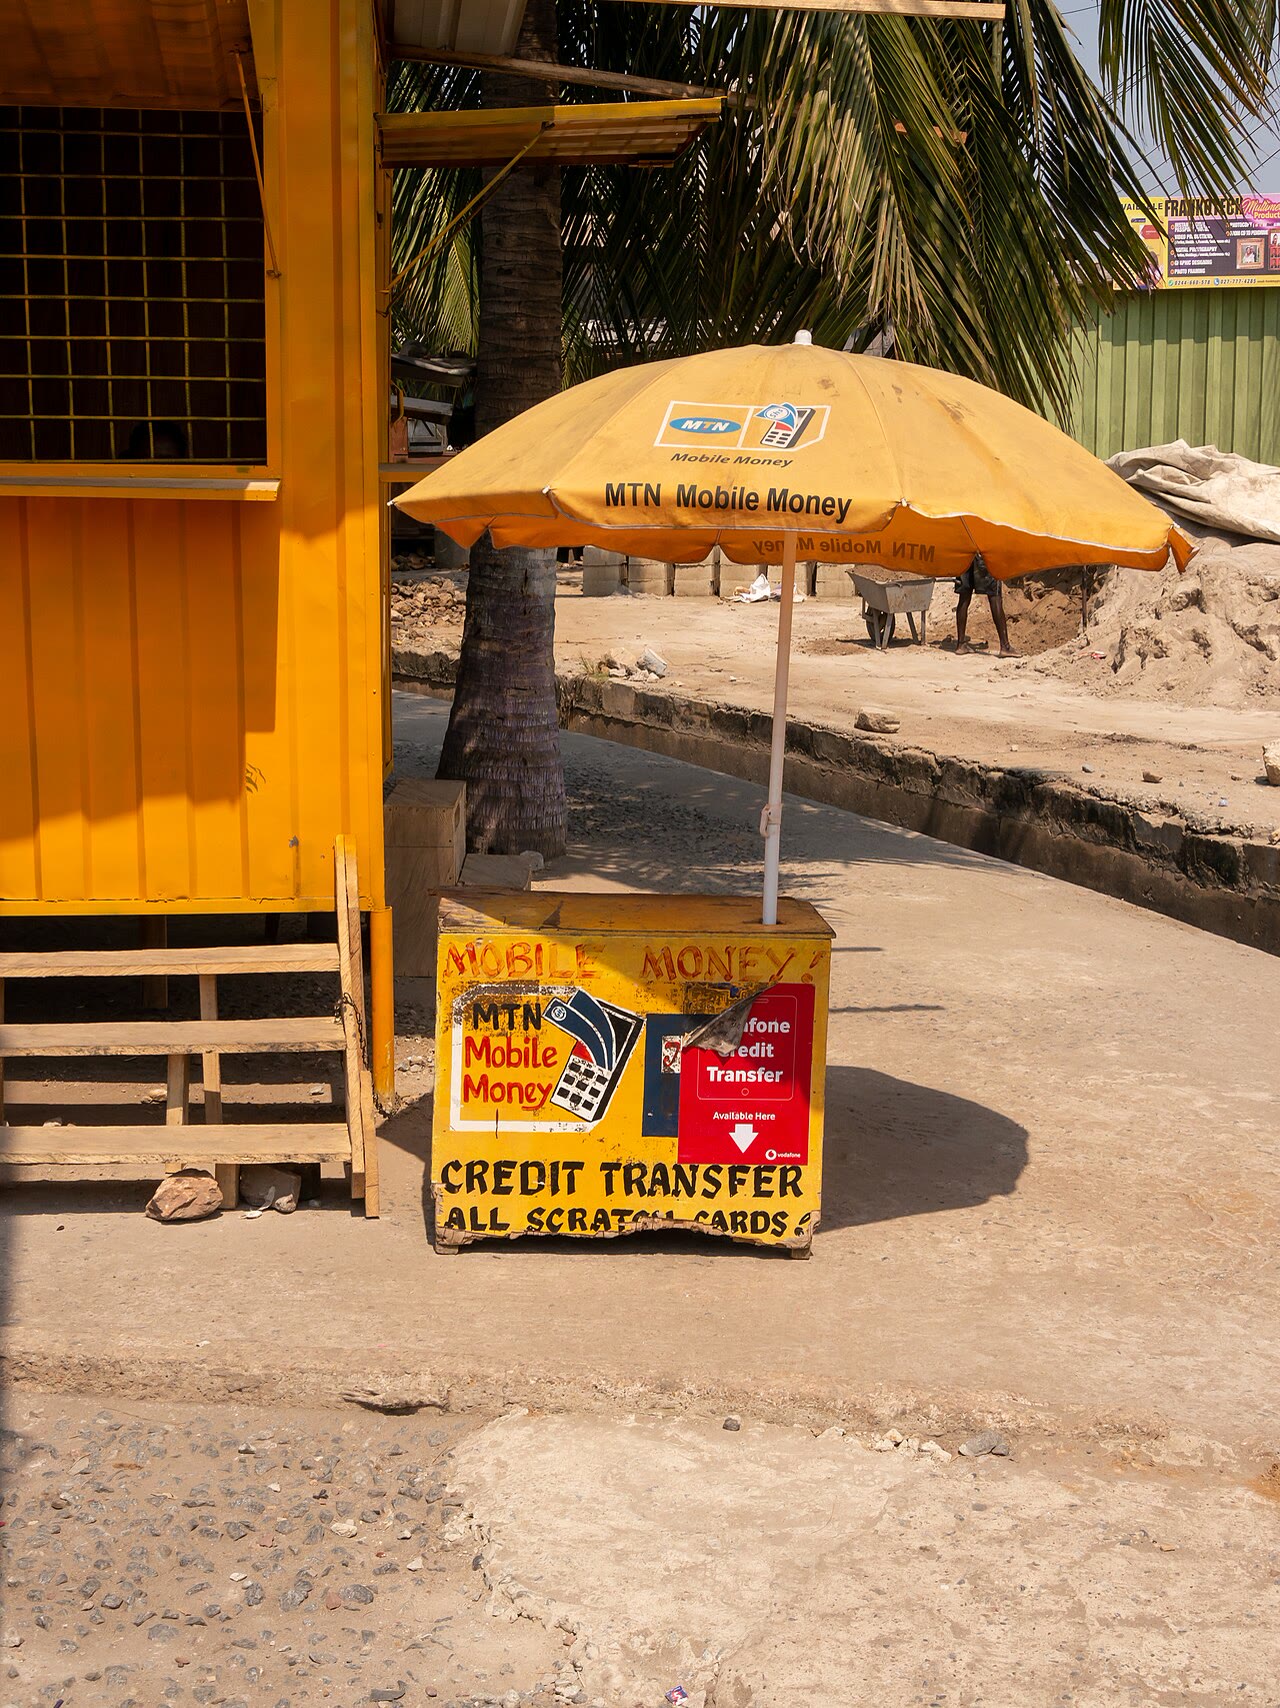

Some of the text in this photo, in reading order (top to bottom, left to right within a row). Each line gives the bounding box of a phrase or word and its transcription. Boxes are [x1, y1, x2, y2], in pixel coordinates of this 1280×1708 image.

[1164, 198, 1243, 217] FRAKOECH
[681, 420, 730, 432] MTN
[670, 453, 794, 468] Mobile Money
[605, 482, 852, 524] MTN Mobile Money
[442, 942, 604, 980] MOBILE
[472, 1002, 543, 1032] MTN
[464, 1036, 558, 1069] Mobile
[706, 1066, 784, 1083] Transfer
[463, 1073, 553, 1111] Money
[713, 1111, 776, 1121] Available Here
[777, 1151, 801, 1159] vodafone
[440, 1159, 803, 1199] CREDIT TRANSFER
[444, 1206, 511, 1231] ALL
